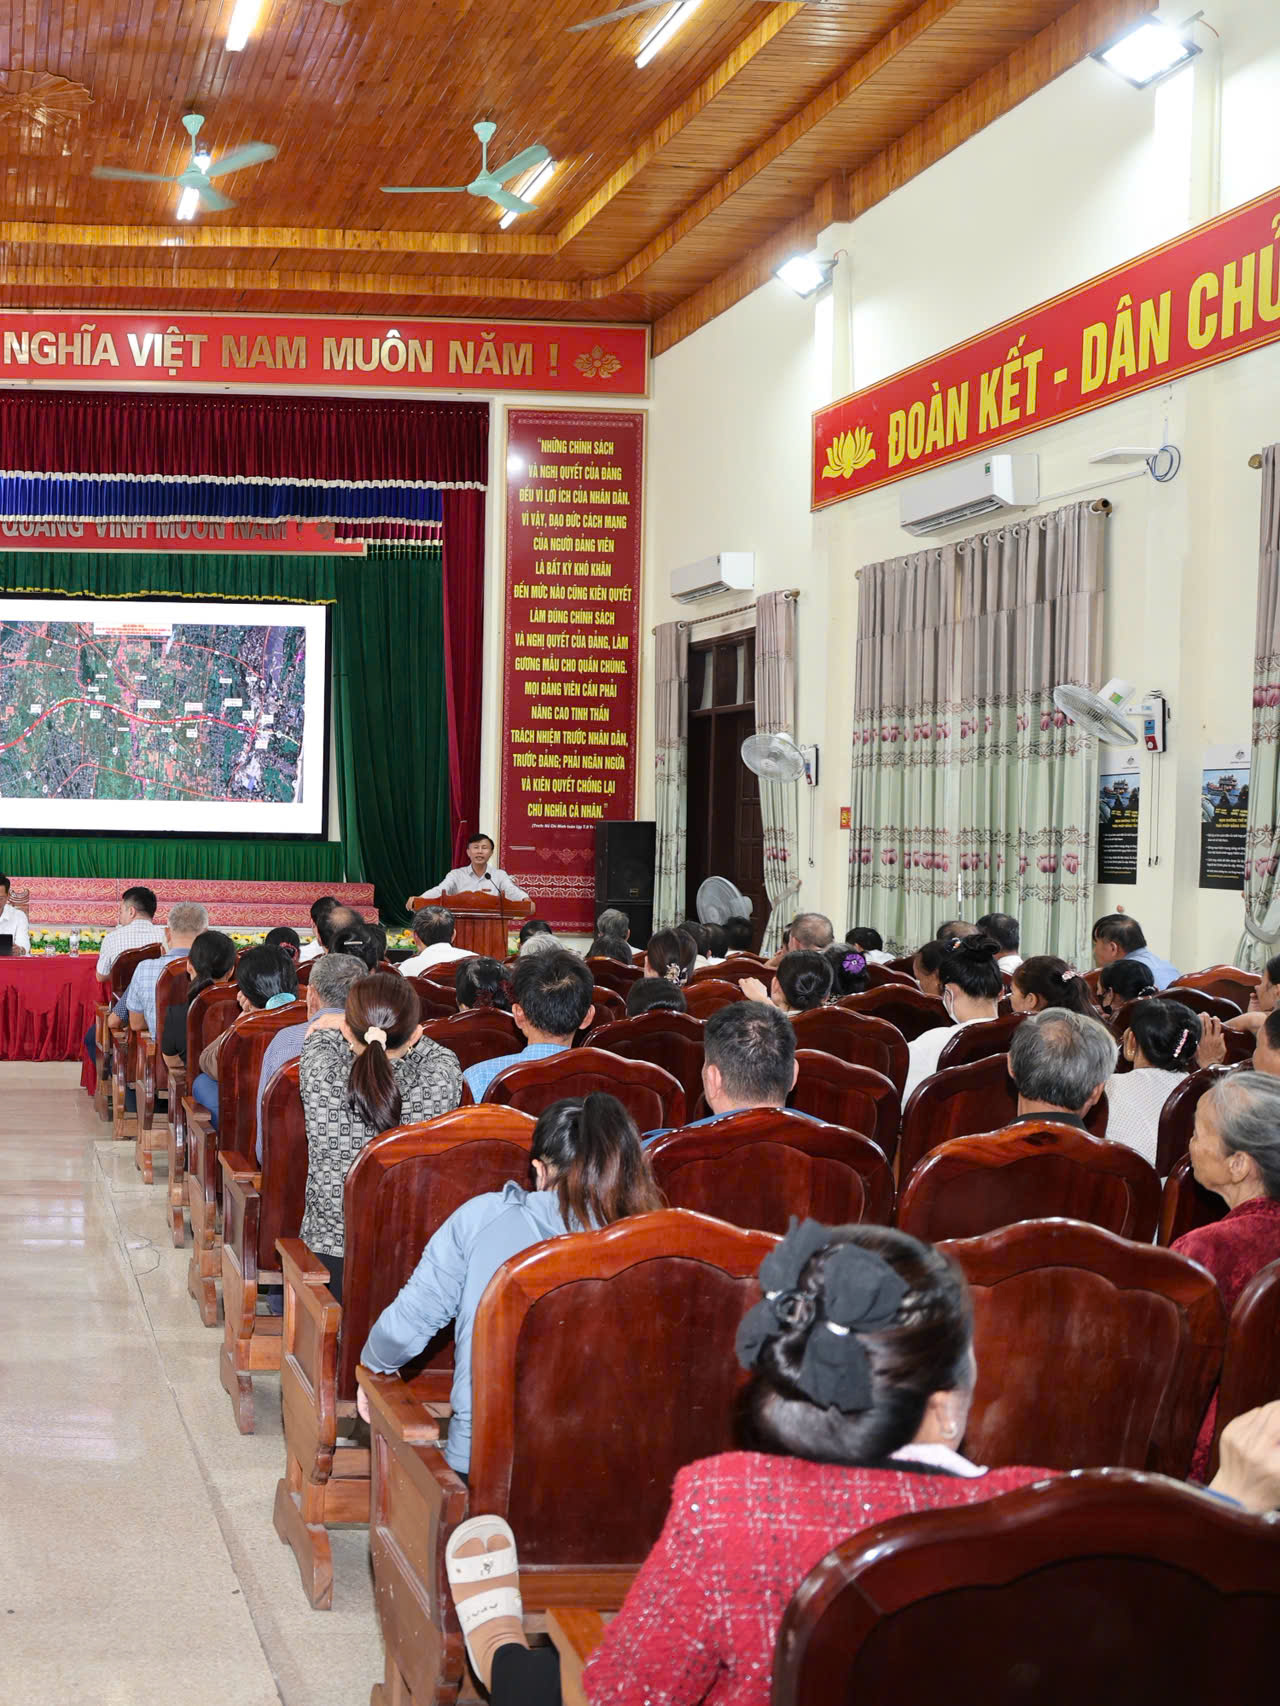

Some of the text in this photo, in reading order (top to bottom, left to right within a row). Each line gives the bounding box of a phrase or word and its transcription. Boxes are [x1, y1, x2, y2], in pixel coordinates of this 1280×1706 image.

[4, 323, 119, 368] NGHĨA
[127, 326, 208, 375] VIỆT
[222, 335, 306, 370] NAM
[323, 329, 433, 373] MUÔN
[447, 331, 533, 376] NĂM
[888, 381, 969, 469] ĐOÀN
[978, 335, 1044, 434] KẾT
[1081, 289, 1172, 395] DÂN
[519, 483, 630, 507] ĐỀU VÌ LỢI ÍCH CỦA NHÂN DÂN.
[522, 510, 528, 526] VÌ
[549, 513, 563, 531] ĐẠO
[566, 509, 580, 528] ĐỨC
[583, 511, 602, 528] CÁCH
[605, 515, 626, 533] MẠNG
[534, 532, 614, 553] CỦA NGƯỜI ĐẢNG VIÊN
[536, 556, 611, 577] LÀ BẤT KỲ KHÓ KHĂN
[514, 578, 631, 601] ĐẾN MỨC NÀO CŨNG KIÊN QUYẾT
[530, 606, 614, 625] LÀM ĐÚNG CHÍNH SÁCH
[515, 628, 628, 651] VÀ NGHỊ QUYẾT CỦA ĐẢNG, LÀM
[525, 676, 616, 700] MỌI ĐẢNG VIÊN CẦN PHẢI
[532, 702, 609, 721] NÂNG CAO TINH THẦN
[512, 726, 628, 748] TRÁCH NHIỆM TRƯỚC NHÂN DÂN,
[522, 773, 615, 798] VÀ KIÊN QUYẾT CHỐNG LẠI
